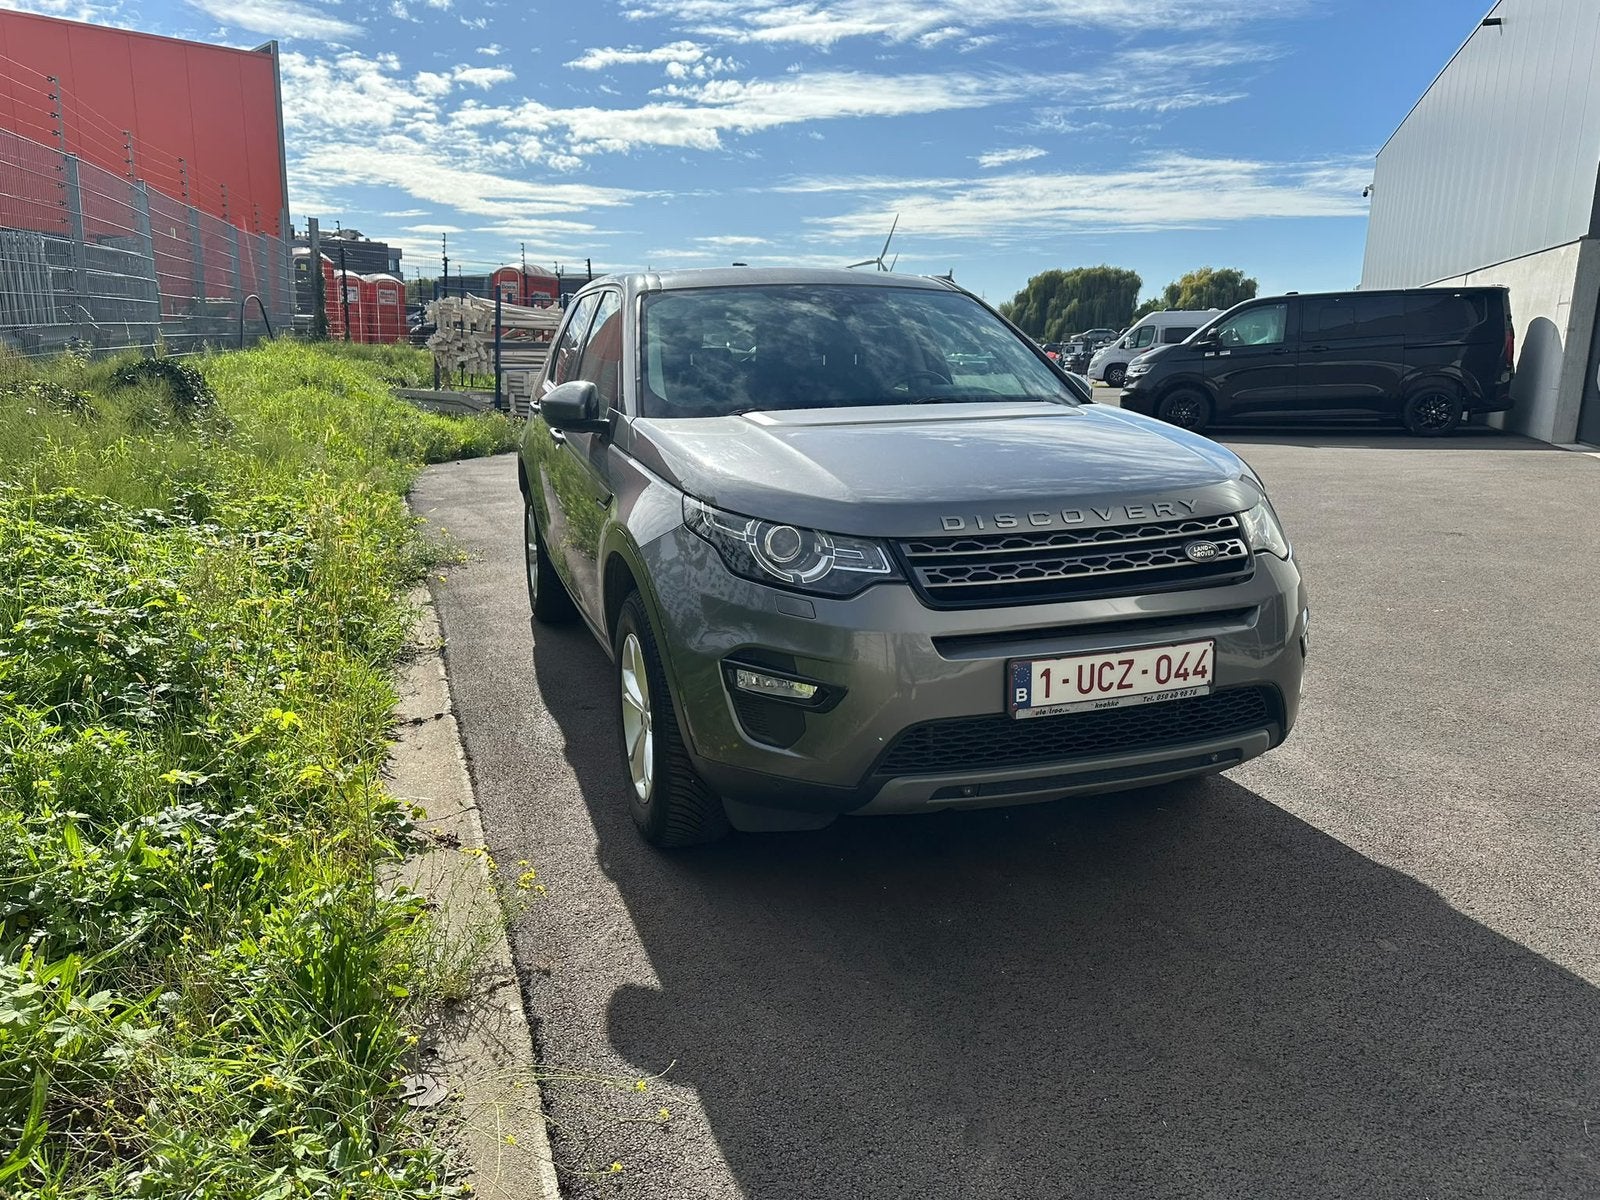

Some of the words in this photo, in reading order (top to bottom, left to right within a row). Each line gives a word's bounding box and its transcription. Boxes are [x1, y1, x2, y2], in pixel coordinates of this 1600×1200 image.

[939, 499, 1198, 531] DISCOVERY
[1193, 545, 1209, 553] LAND
[1196, 549, 1215, 558] ROVER
[1039, 648, 1209, 699] 1-UCZ-044
[1015, 687, 1028, 703] B
